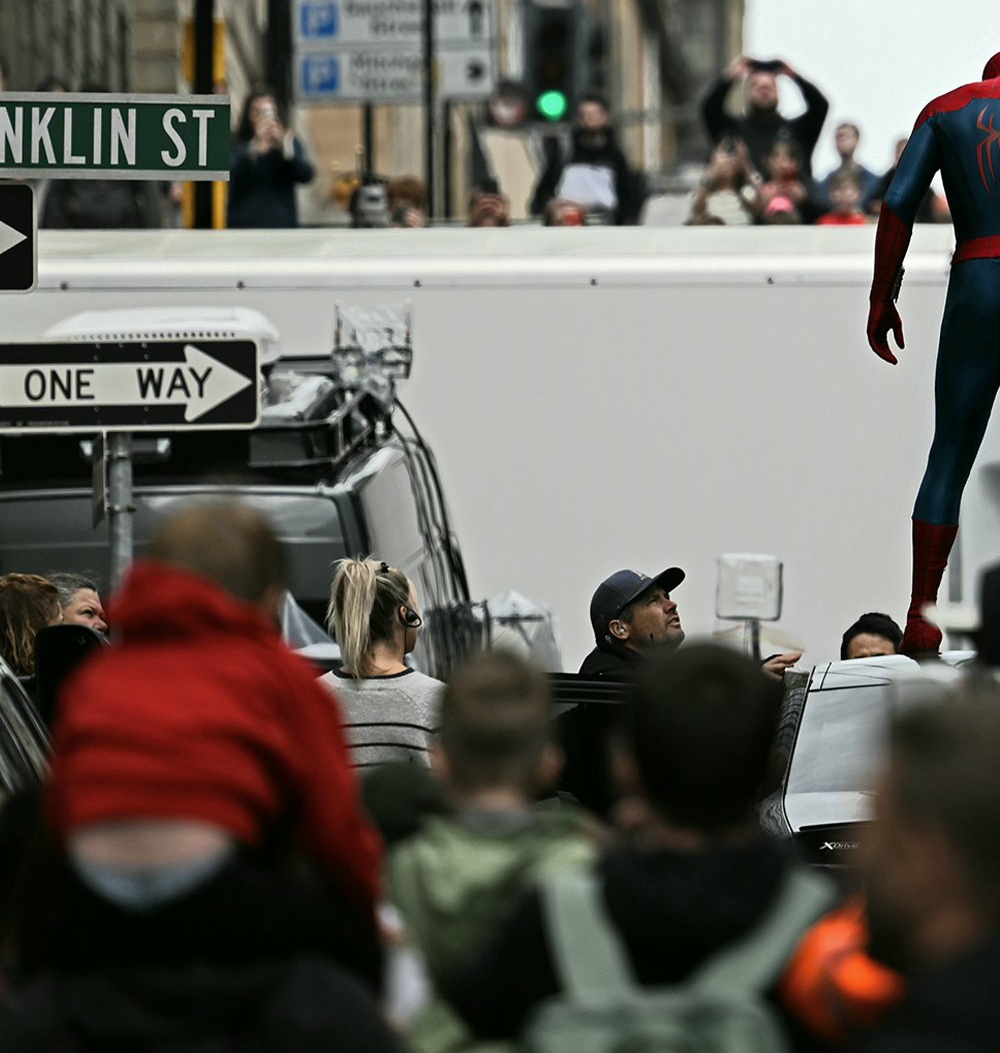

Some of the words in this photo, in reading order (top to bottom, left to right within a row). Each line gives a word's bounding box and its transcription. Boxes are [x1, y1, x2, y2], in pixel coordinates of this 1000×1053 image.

[0, 107, 136, 165] NKLIN
[161, 108, 215, 167] ST
[24, 369, 95, 401] ONE
[136, 367, 212, 399] WAY
